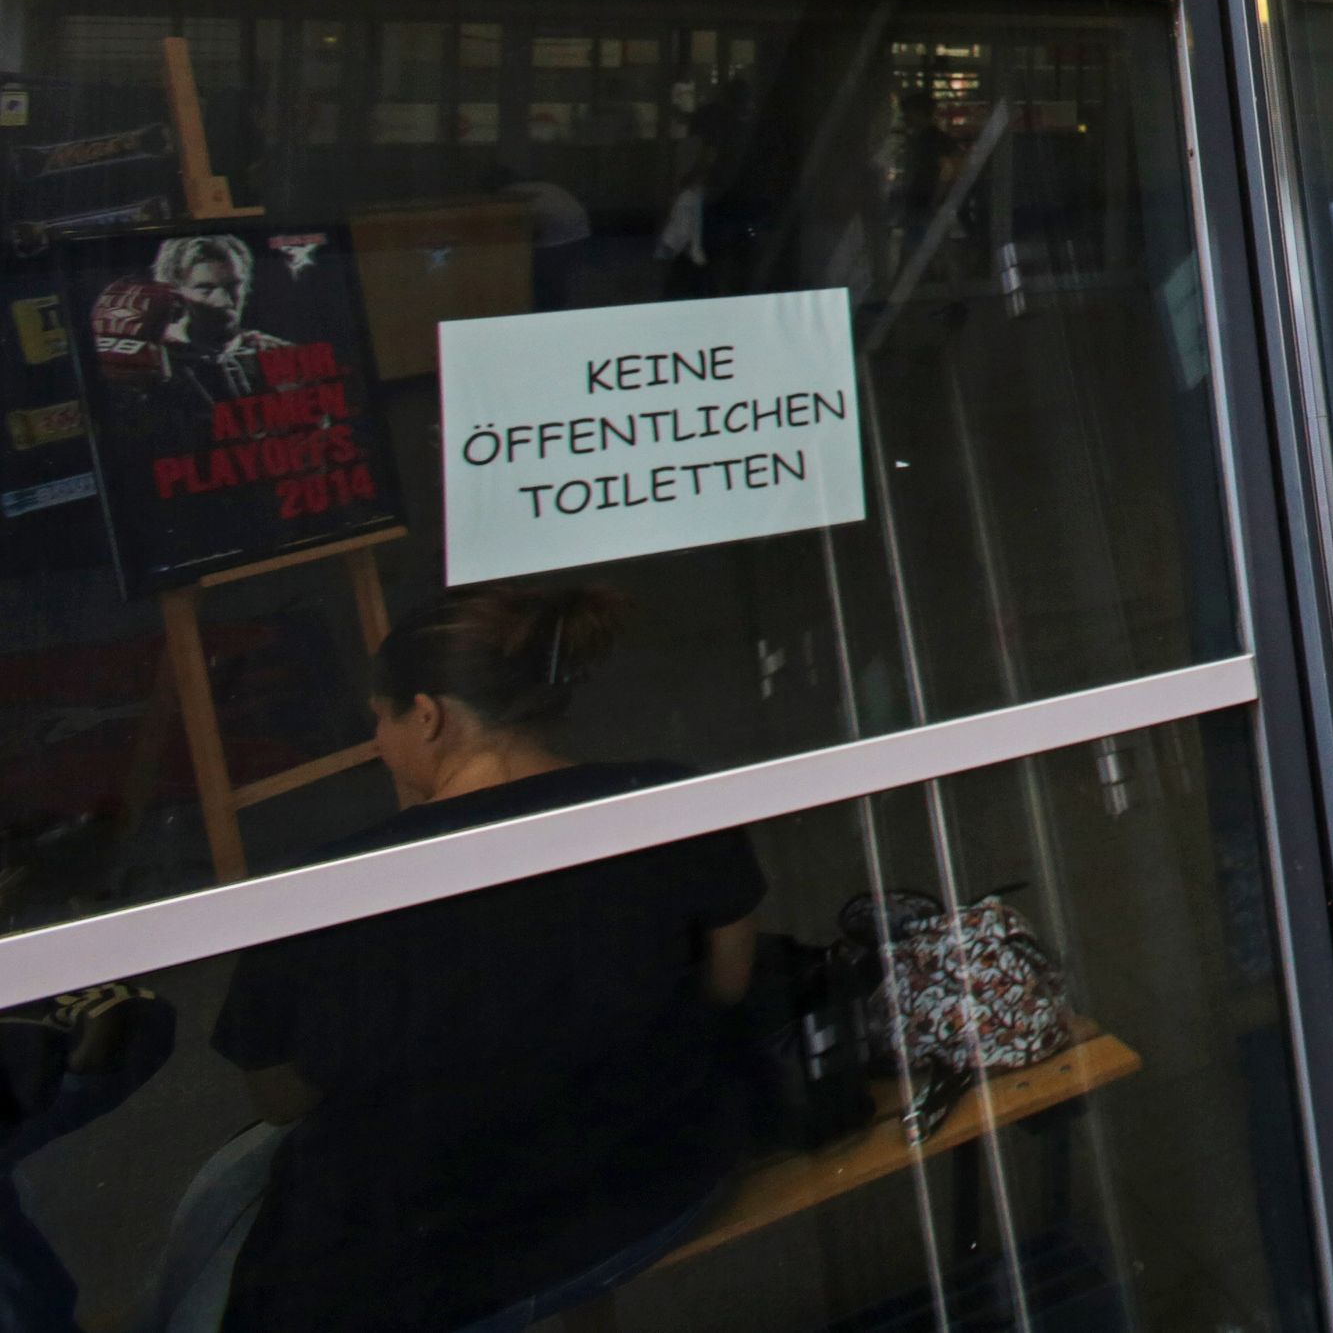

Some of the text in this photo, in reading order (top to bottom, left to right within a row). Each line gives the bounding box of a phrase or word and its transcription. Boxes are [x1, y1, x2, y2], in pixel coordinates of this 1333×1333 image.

[585, 345, 737, 395] KEINE
[461, 389, 848, 467] ÖFFENTLICHEN
[274, 464, 378, 521] 2014
[518, 450, 807, 520] TOILETTEN
